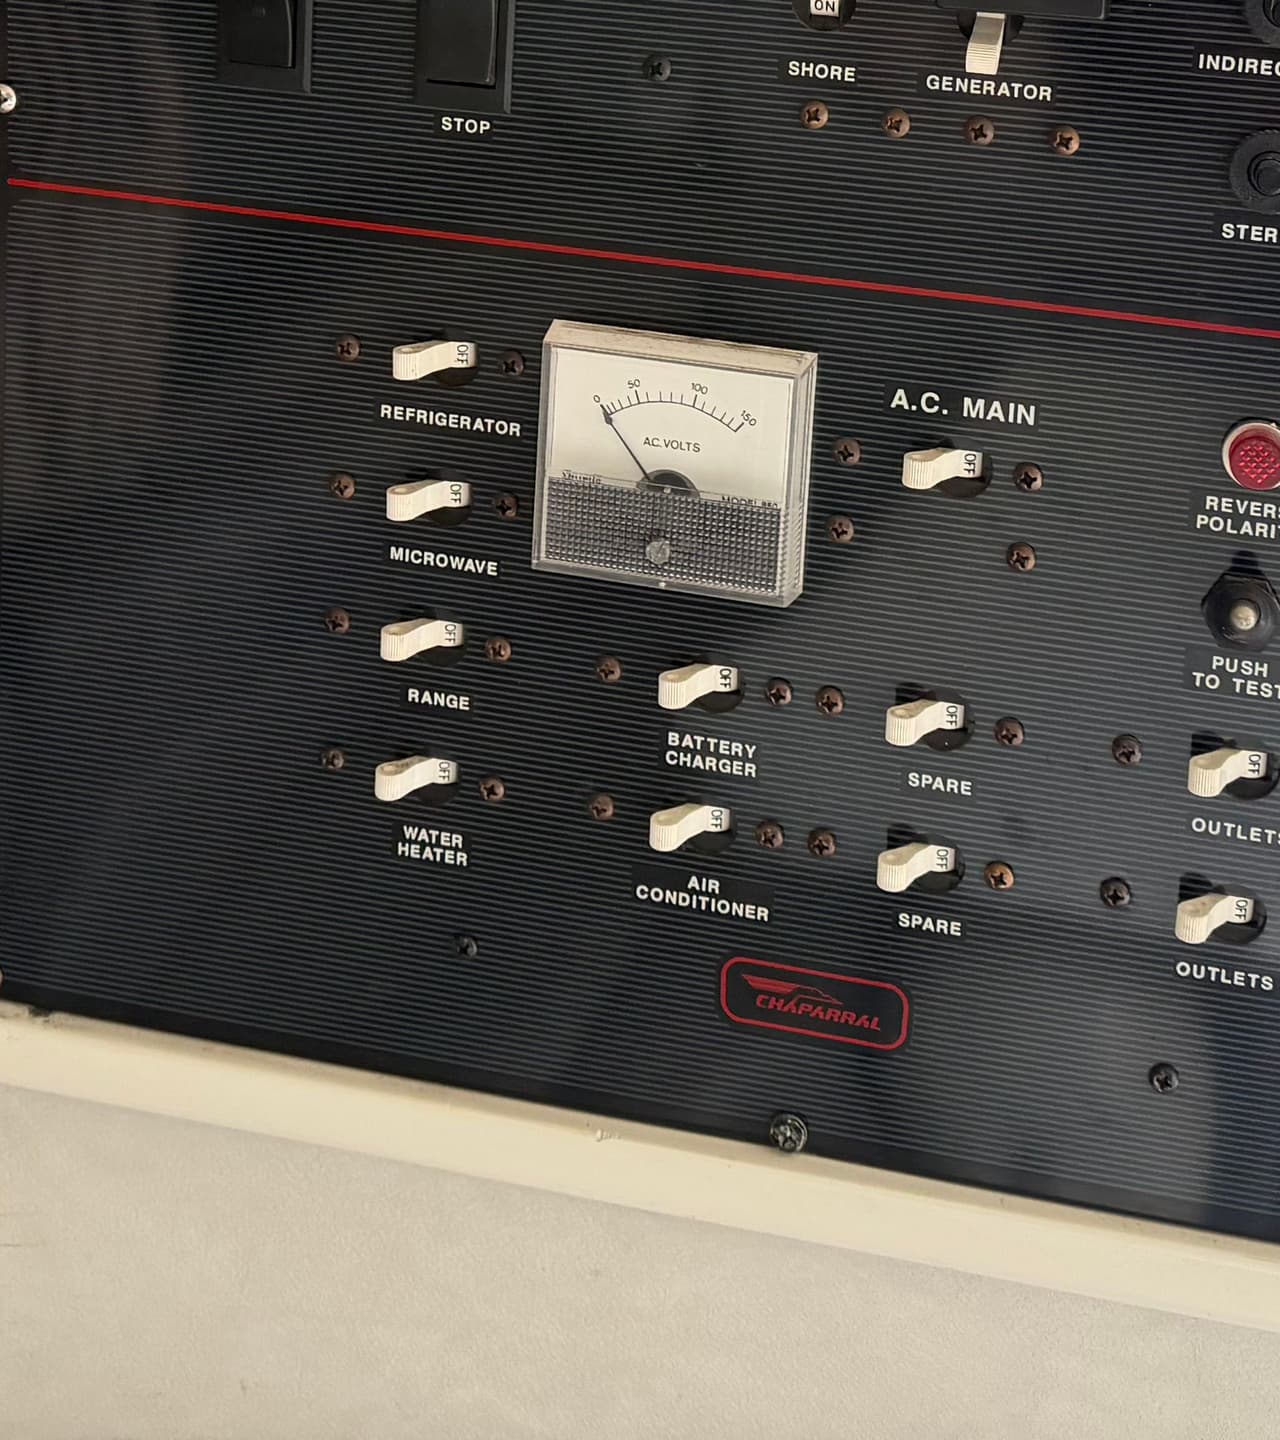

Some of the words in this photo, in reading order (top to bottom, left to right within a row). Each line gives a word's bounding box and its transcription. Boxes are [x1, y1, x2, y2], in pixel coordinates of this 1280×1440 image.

[814, 0, 836, 13] ON
[787, 60, 857, 82] SHORE
[926, 75, 1053, 101] GENERATOR
[441, 116, 491, 135] STOP
[455, 343, 469, 366] OFF
[627, 378, 641, 389] 50
[691, 382, 708, 395] 100
[593, 394, 601, 404] 0
[890, 388, 949, 415] A.C.
[962, 397, 1036, 426] MAIN
[380, 404, 521, 437] REFRIGERATOR
[740, 410, 757, 427] 150
[963, 452, 977, 475] OFF
[450, 483, 463, 505] OFF
[389, 546, 498, 576] MICROWAVE
[444, 623, 457, 645] OFF
[719, 667, 732, 689] OFF
[1211, 655, 1269, 678] PUSH
[1192, 671, 1221, 690] TO
[407, 688, 470, 710] RANGE
[945, 705, 958, 727] OFF
[667, 732, 757, 759] BATTERY
[438, 761, 450, 782] OFF
[665, 751, 757, 778] CHARGER
[1248, 753, 1261, 776] OFF
[907, 772, 972, 796] SPARE
[711, 809, 723, 830] OFF
[403, 825, 463, 848] WATER
[397, 842, 468, 867] HEATER
[936, 848, 949, 870] OFF
[687, 875, 720, 894] AIR
[635, 885, 769, 922] CONDITIONER
[1235, 898, 1248, 921] OFF
[898, 912, 962, 936] SPARE
[1176, 961, 1274, 991] OUTLETS
[755, 994, 881, 1032] CHAPARRAL
